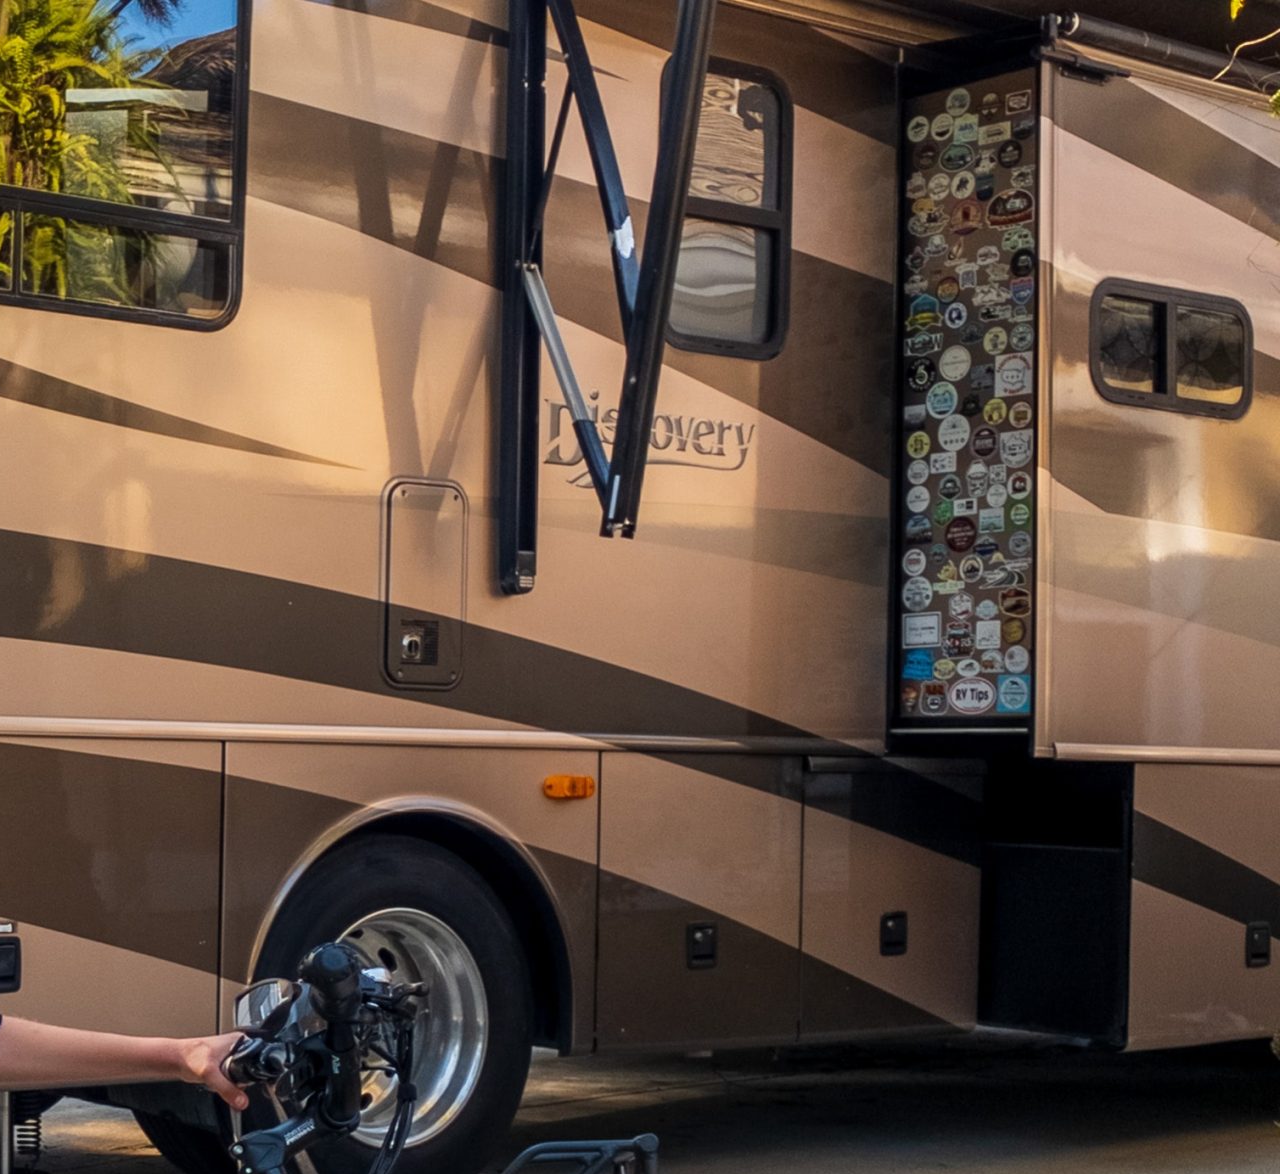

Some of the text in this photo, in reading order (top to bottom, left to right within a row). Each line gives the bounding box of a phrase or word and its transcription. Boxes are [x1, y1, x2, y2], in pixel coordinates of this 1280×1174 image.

[543, 389, 756, 489] Disovery
[955, 688, 967, 701] RV
[970, 687, 990, 703] Tips
